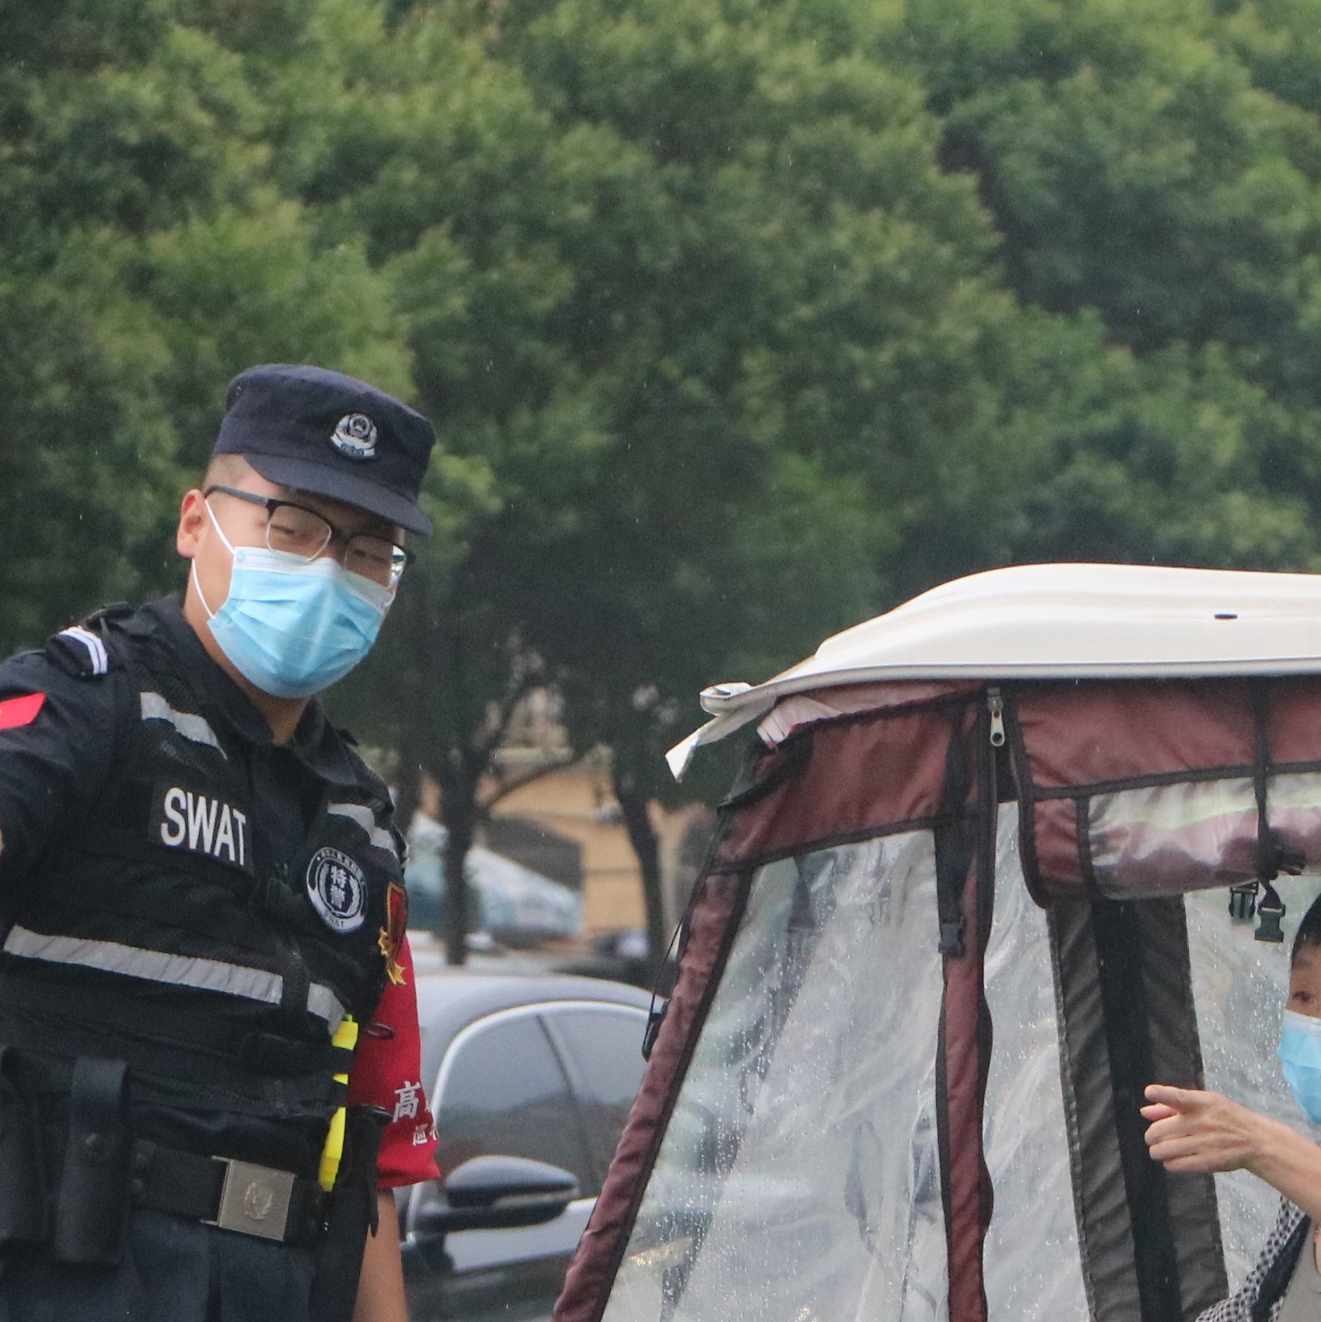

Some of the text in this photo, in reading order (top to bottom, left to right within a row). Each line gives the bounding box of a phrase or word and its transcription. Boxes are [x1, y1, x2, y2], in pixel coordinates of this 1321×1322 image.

[160, 786, 247, 867] SWAT
[329, 864, 348, 910] 特警
[393, 1079, 432, 1123] 高
